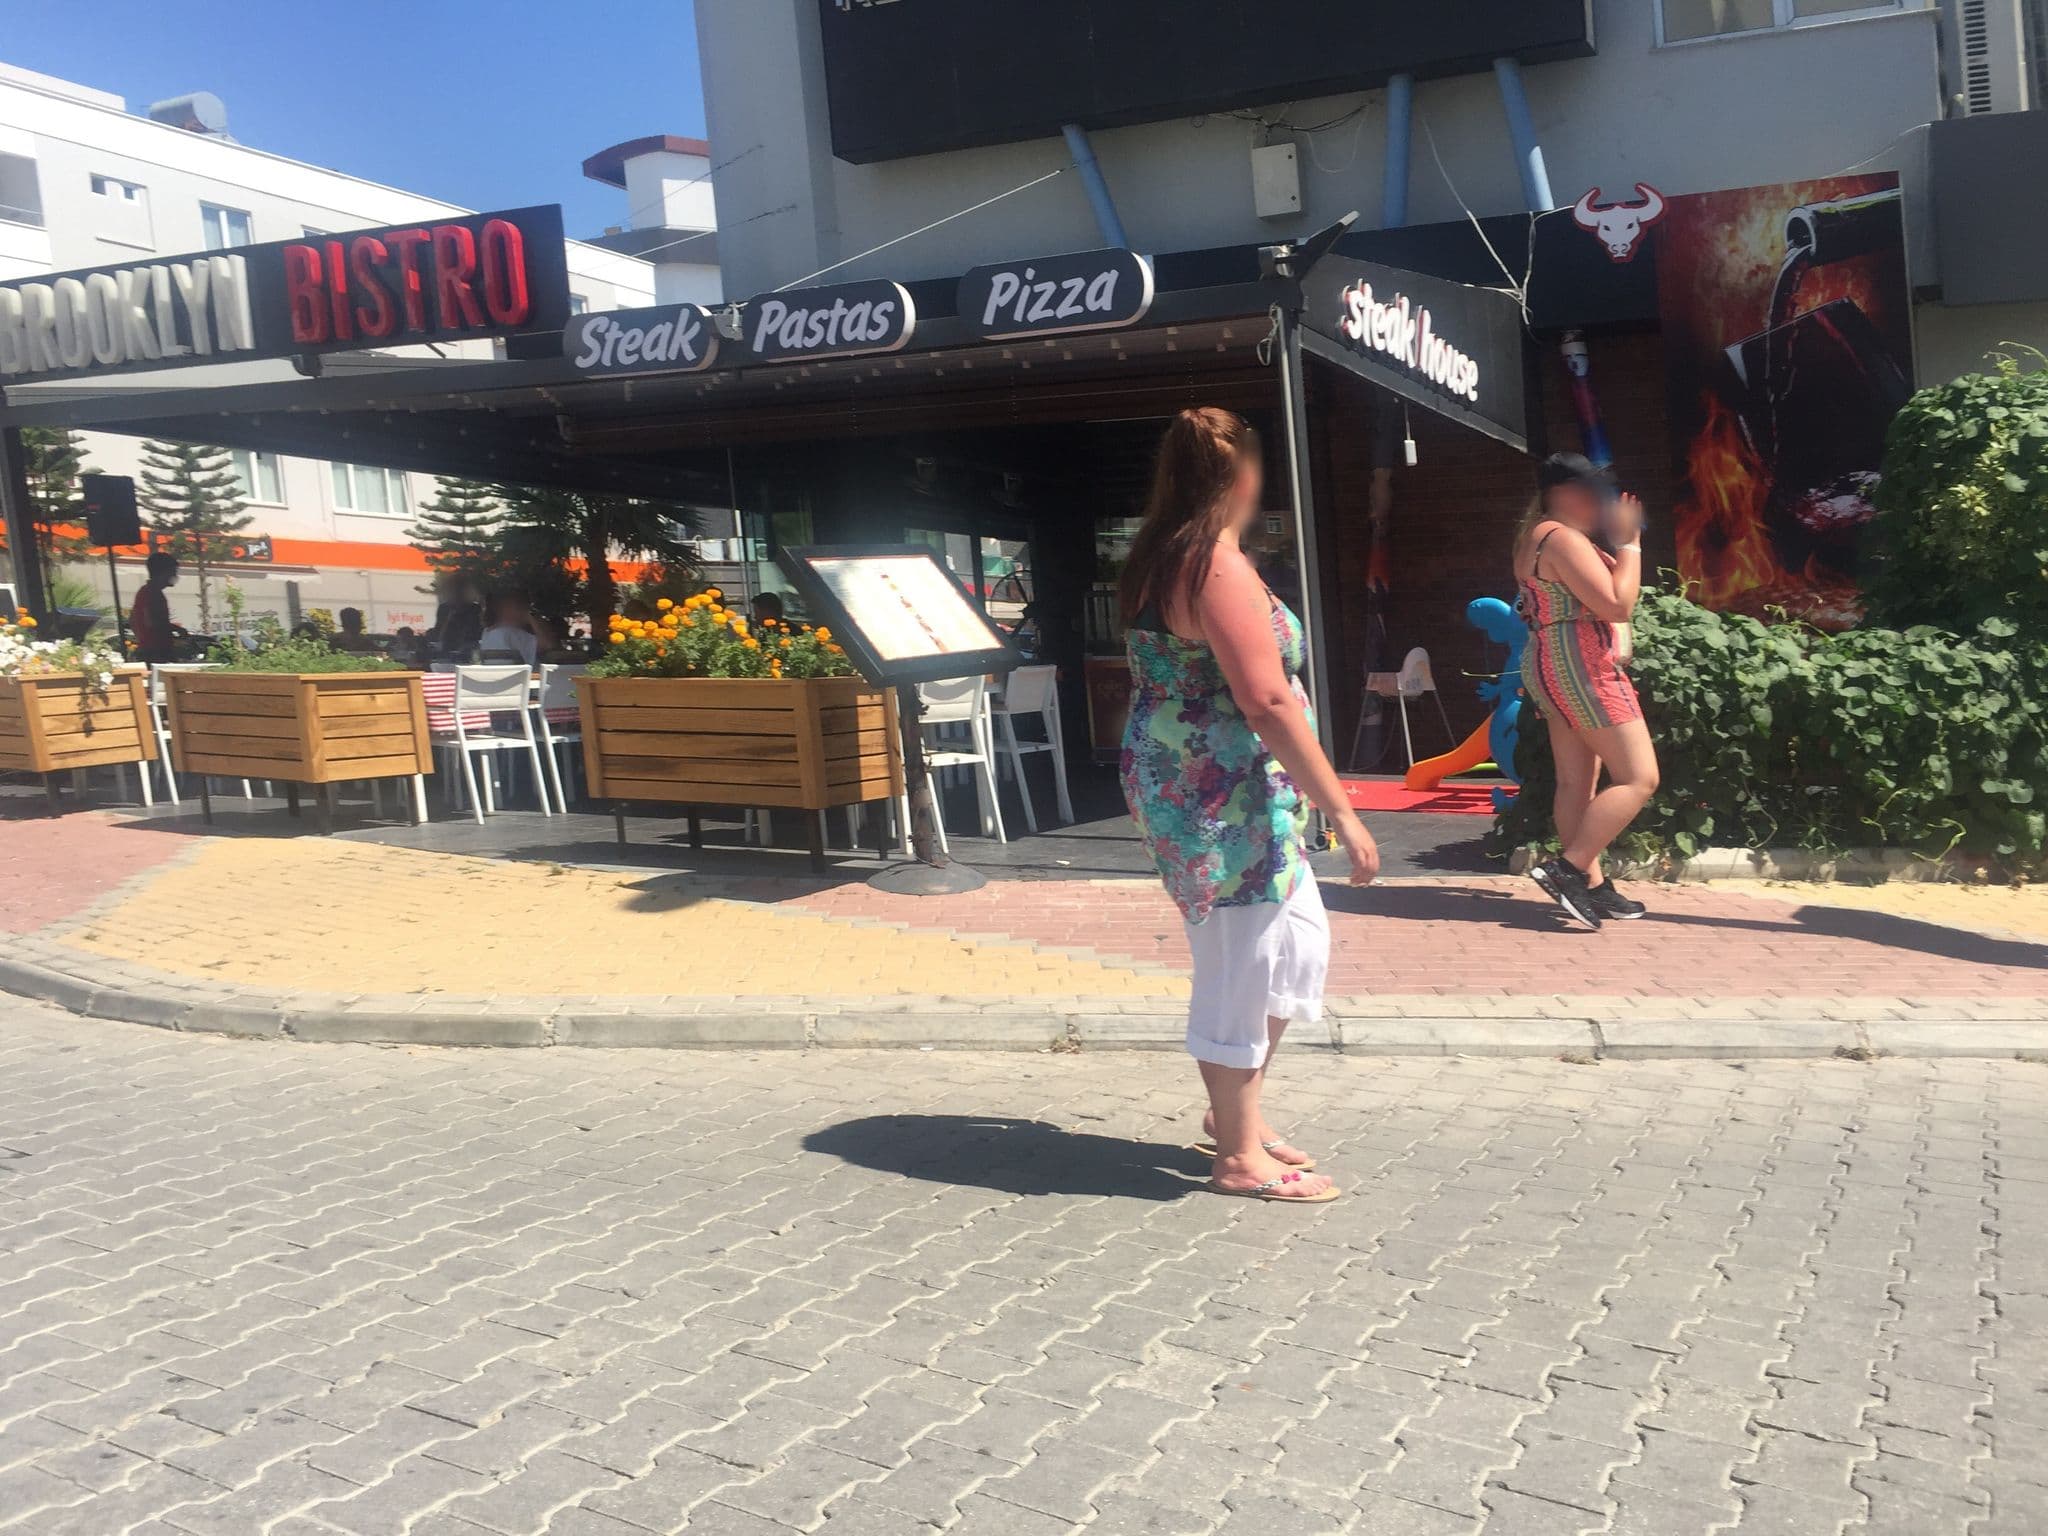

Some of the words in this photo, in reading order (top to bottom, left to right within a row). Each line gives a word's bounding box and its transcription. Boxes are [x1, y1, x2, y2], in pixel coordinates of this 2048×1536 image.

[0, 255, 255, 374] BROOKLYN
[284, 218, 531, 344] BISTRO
[752, 297, 895, 354] Pastas
[982, 267, 1119, 327] Pizza
[574, 308, 701, 369] Steak
[1340, 278, 1416, 369] Steak
[1416, 305, 1478, 402] house
